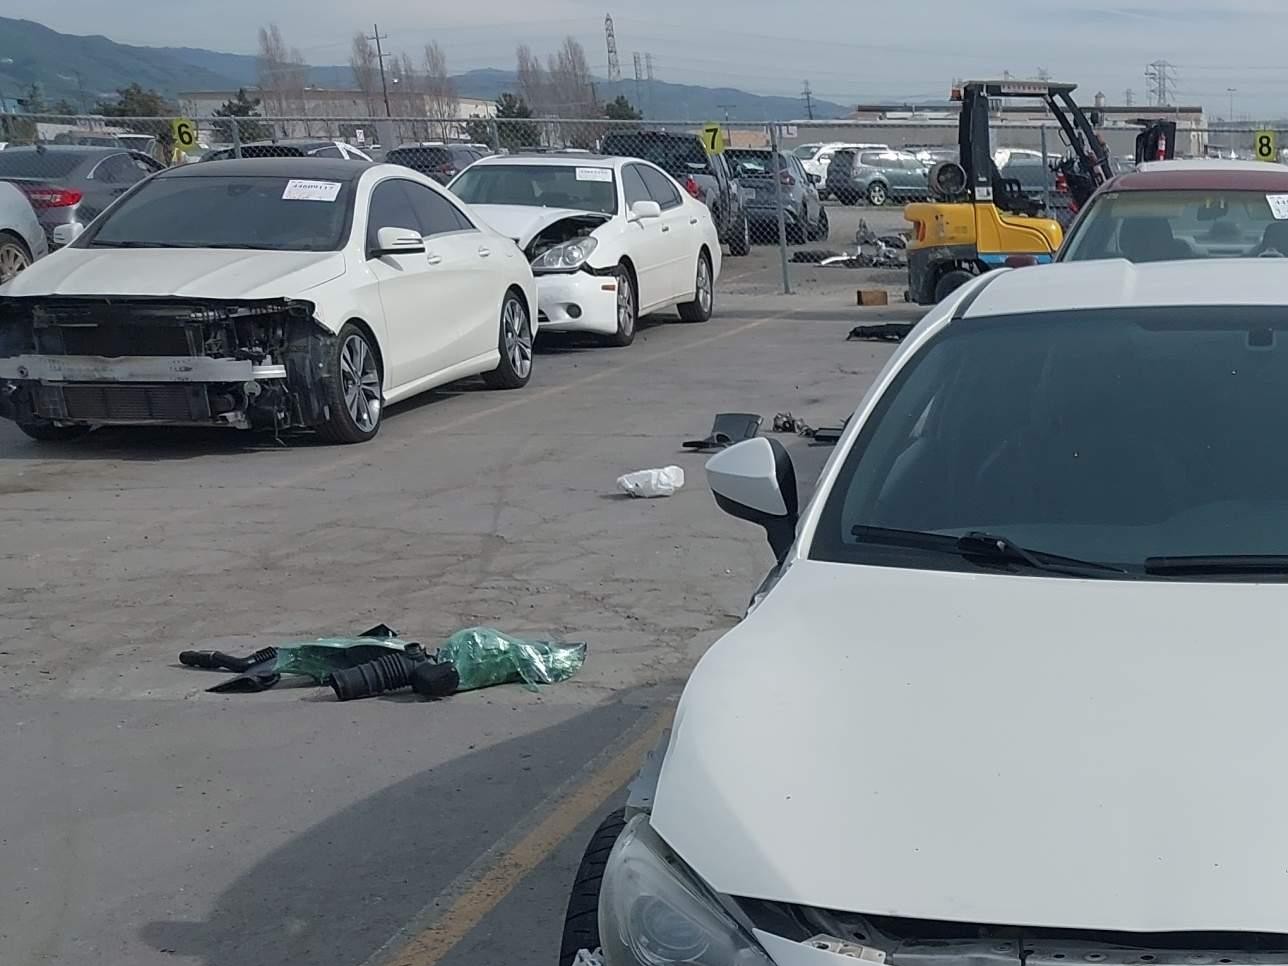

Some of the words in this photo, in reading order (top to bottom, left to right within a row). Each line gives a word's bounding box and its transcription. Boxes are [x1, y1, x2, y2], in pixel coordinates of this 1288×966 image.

[177, 123, 193, 145] 6
[705, 128, 719, 150] 7
[1258, 135, 1272, 157] 8
